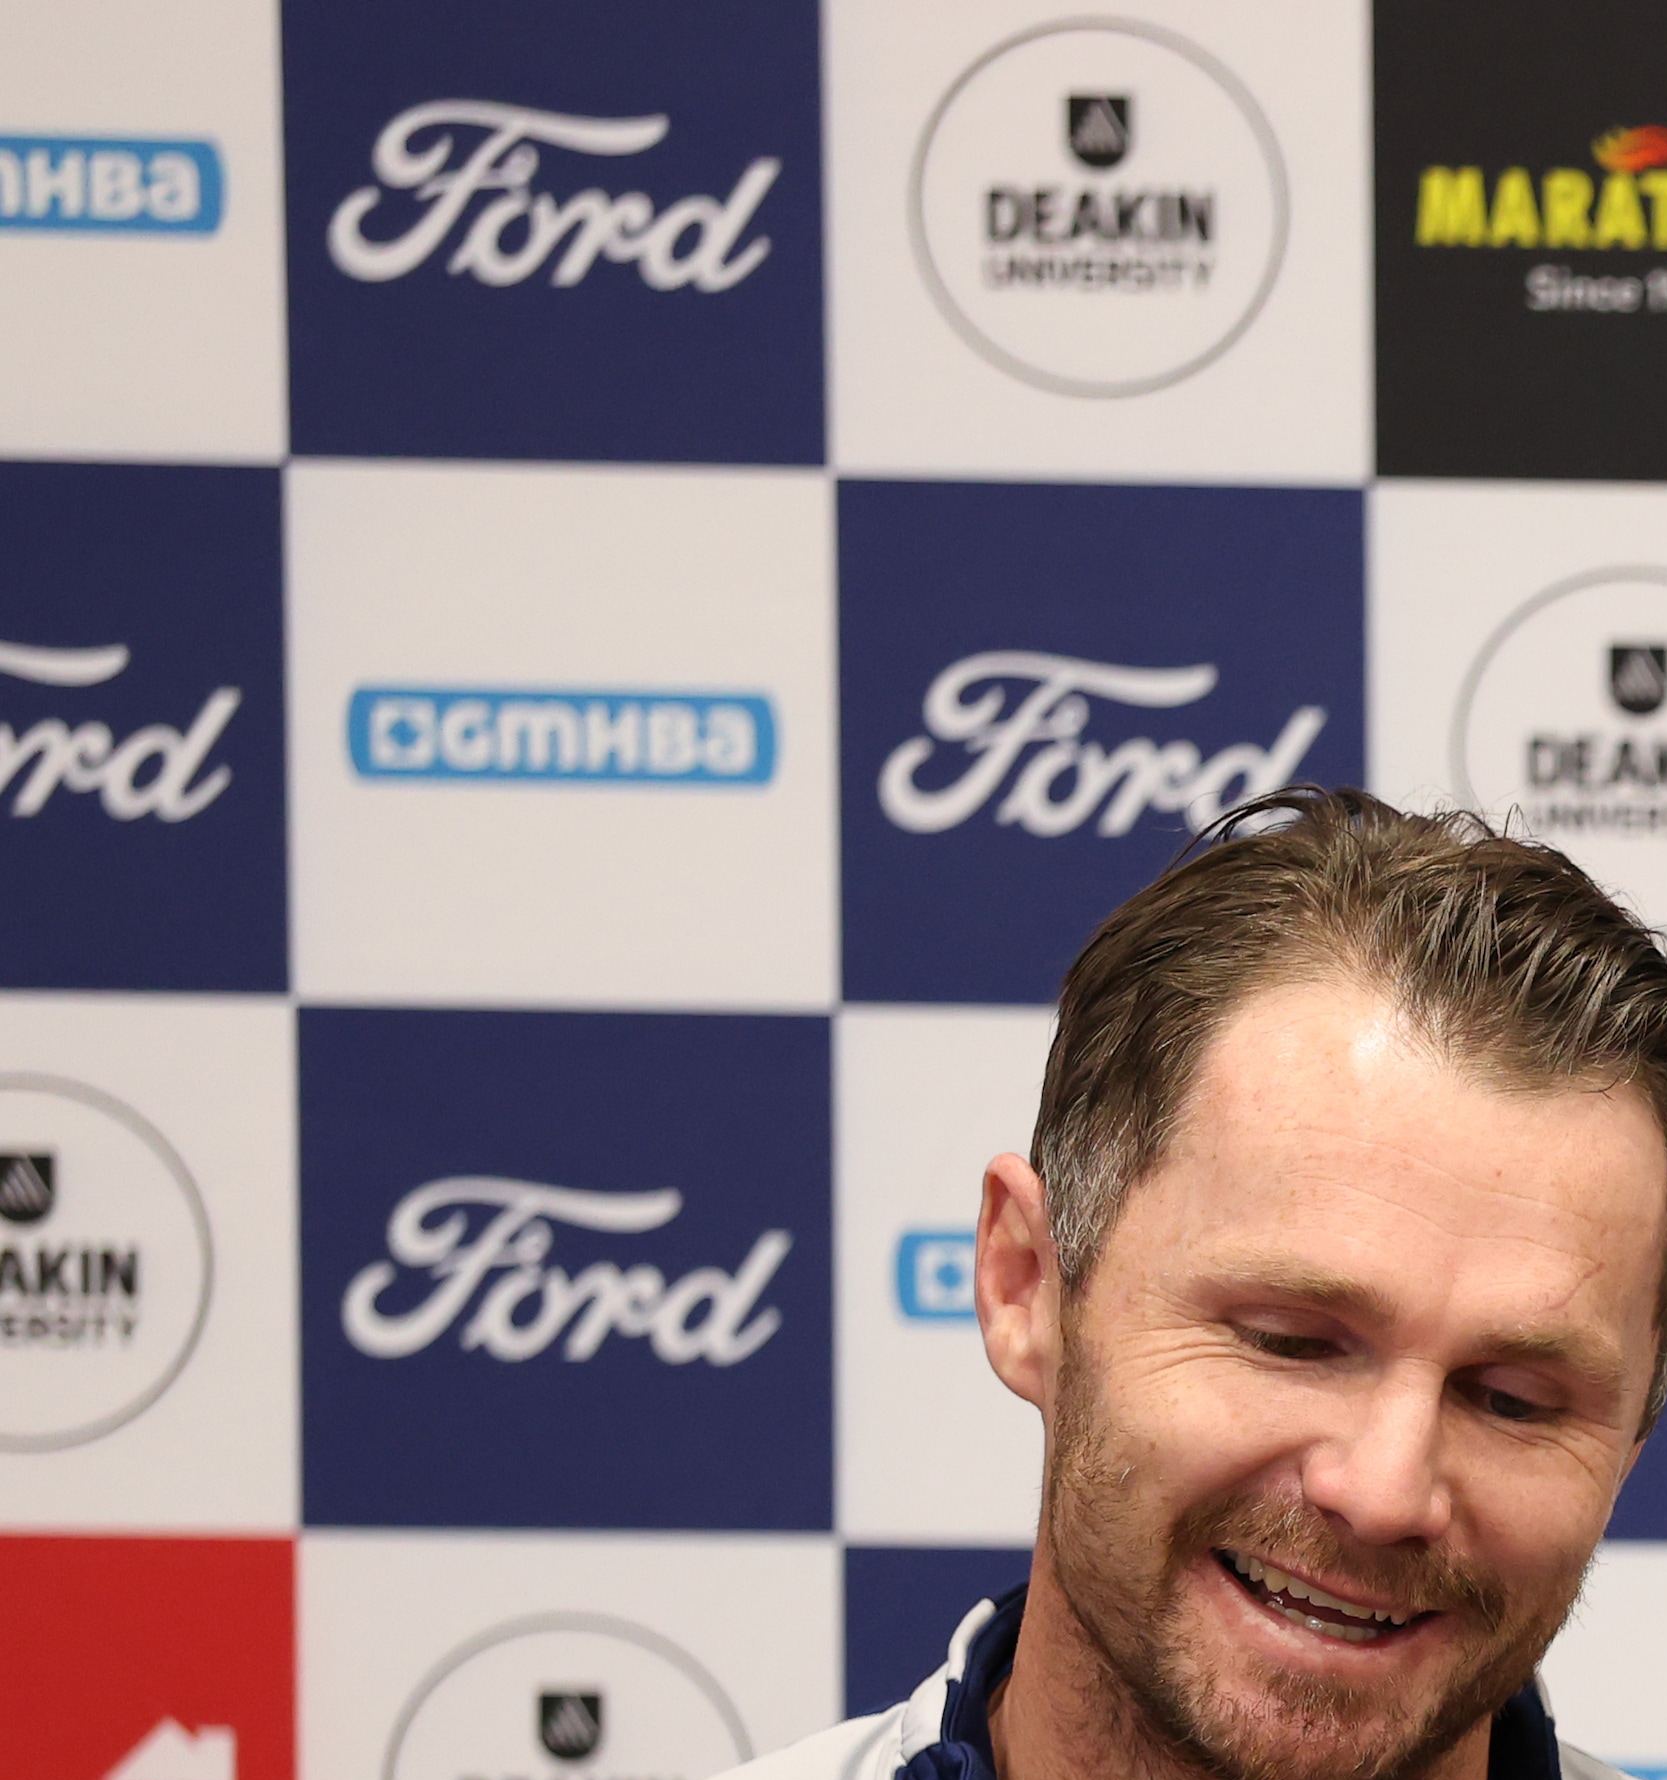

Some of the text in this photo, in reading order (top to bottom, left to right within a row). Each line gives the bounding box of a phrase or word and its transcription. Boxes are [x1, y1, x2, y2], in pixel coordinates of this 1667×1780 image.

[329, 100, 780, 292] Ford
[985, 186, 1214, 243] DEAKIN
[985, 256, 1213, 291] UNIVERSITY
[1526, 266, 1640, 312] Since
[0, 639, 242, 822] rd
[878, 650, 1328, 838] Ford
[0, 1247, 138, 1298] AKIN
[342, 1177, 791, 1365] Ford
